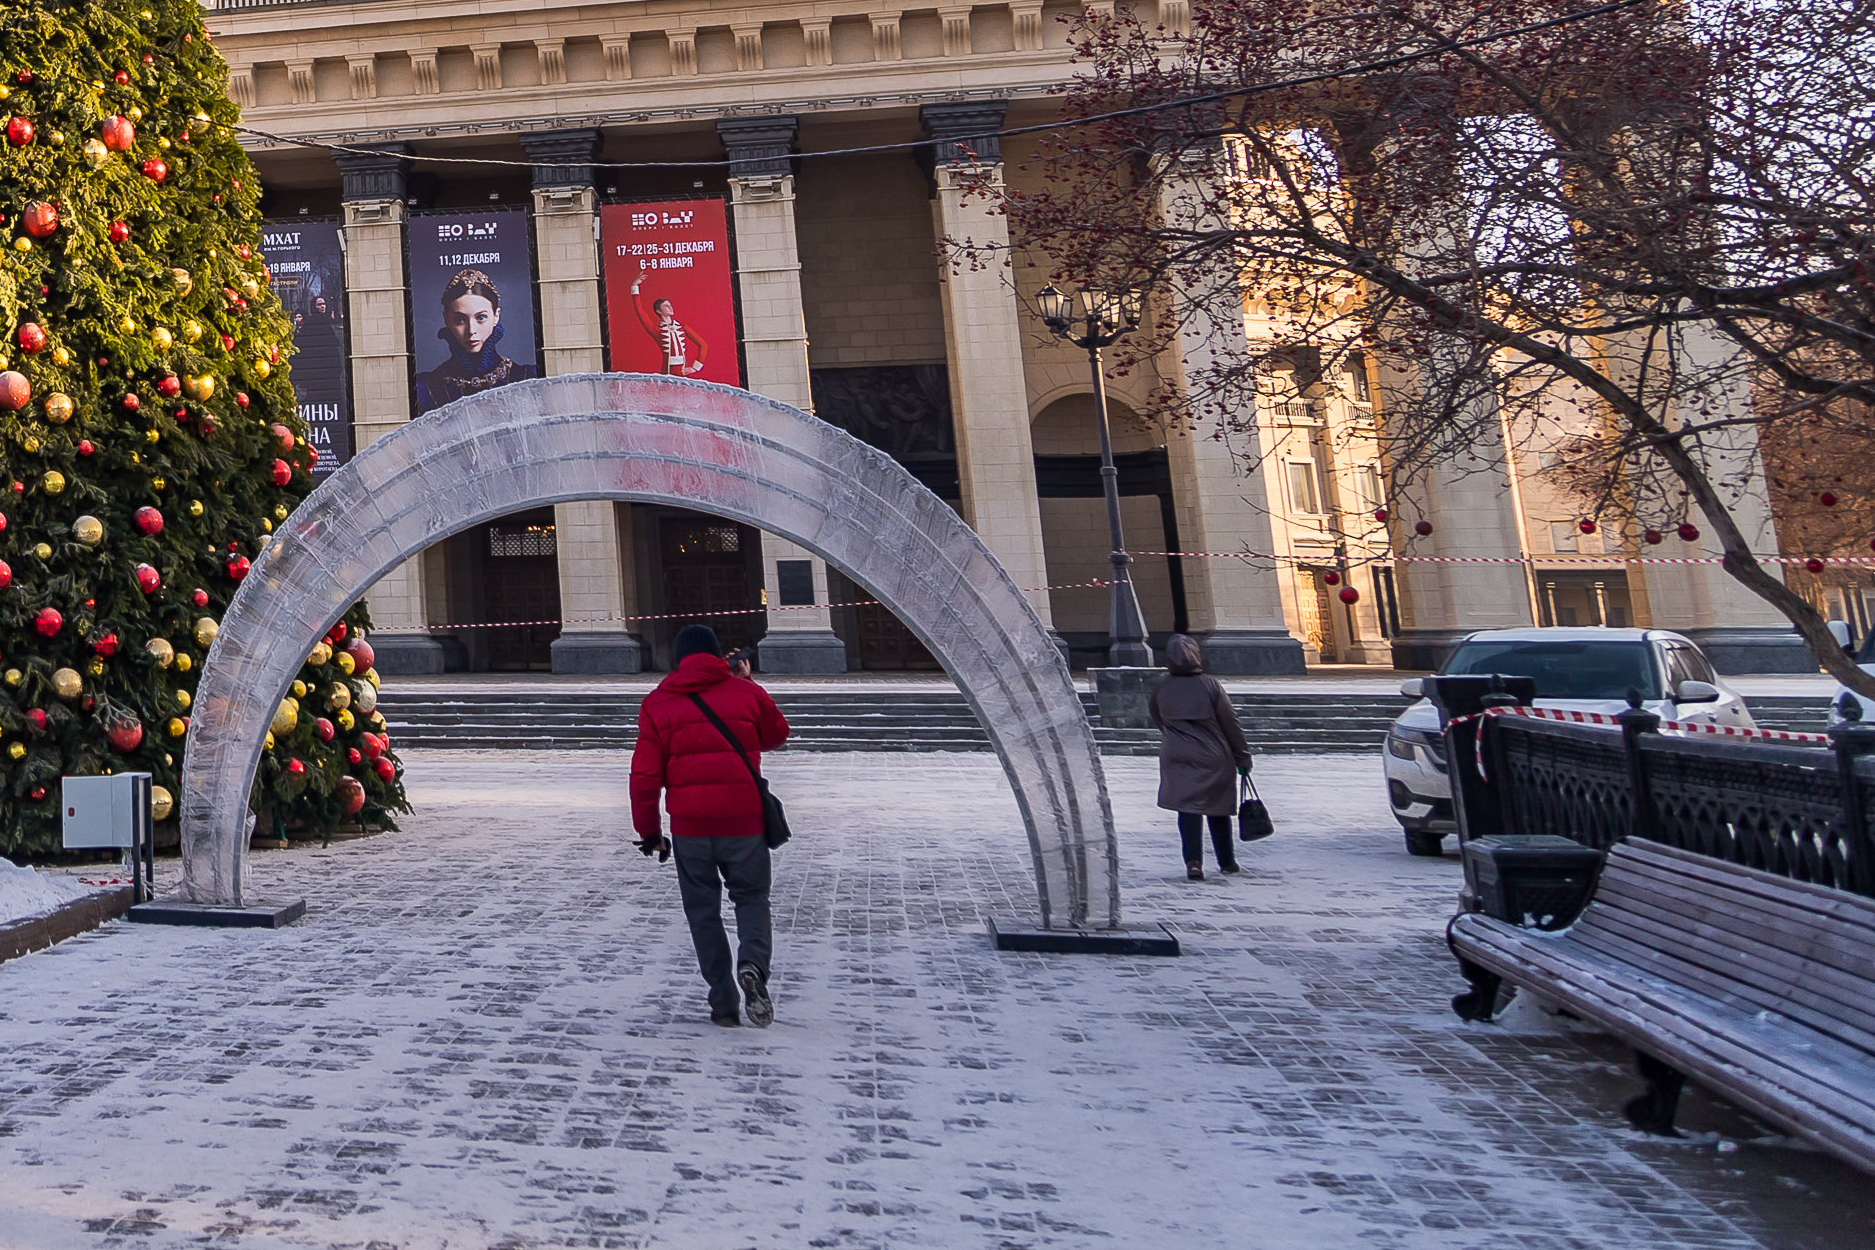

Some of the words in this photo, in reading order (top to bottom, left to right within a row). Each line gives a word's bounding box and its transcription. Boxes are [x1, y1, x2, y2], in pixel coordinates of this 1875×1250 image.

[263, 232, 301, 246] МХАТ
[675, 240, 715, 254] ДЕКАБРЯ
[462, 252, 500, 266] ДЕКАБРЯ
[639, 258, 658, 270] 6-8
[659, 256, 694, 269] ЯНВАРЯ
[280, 261, 311, 273] ЯНВАРЯ
